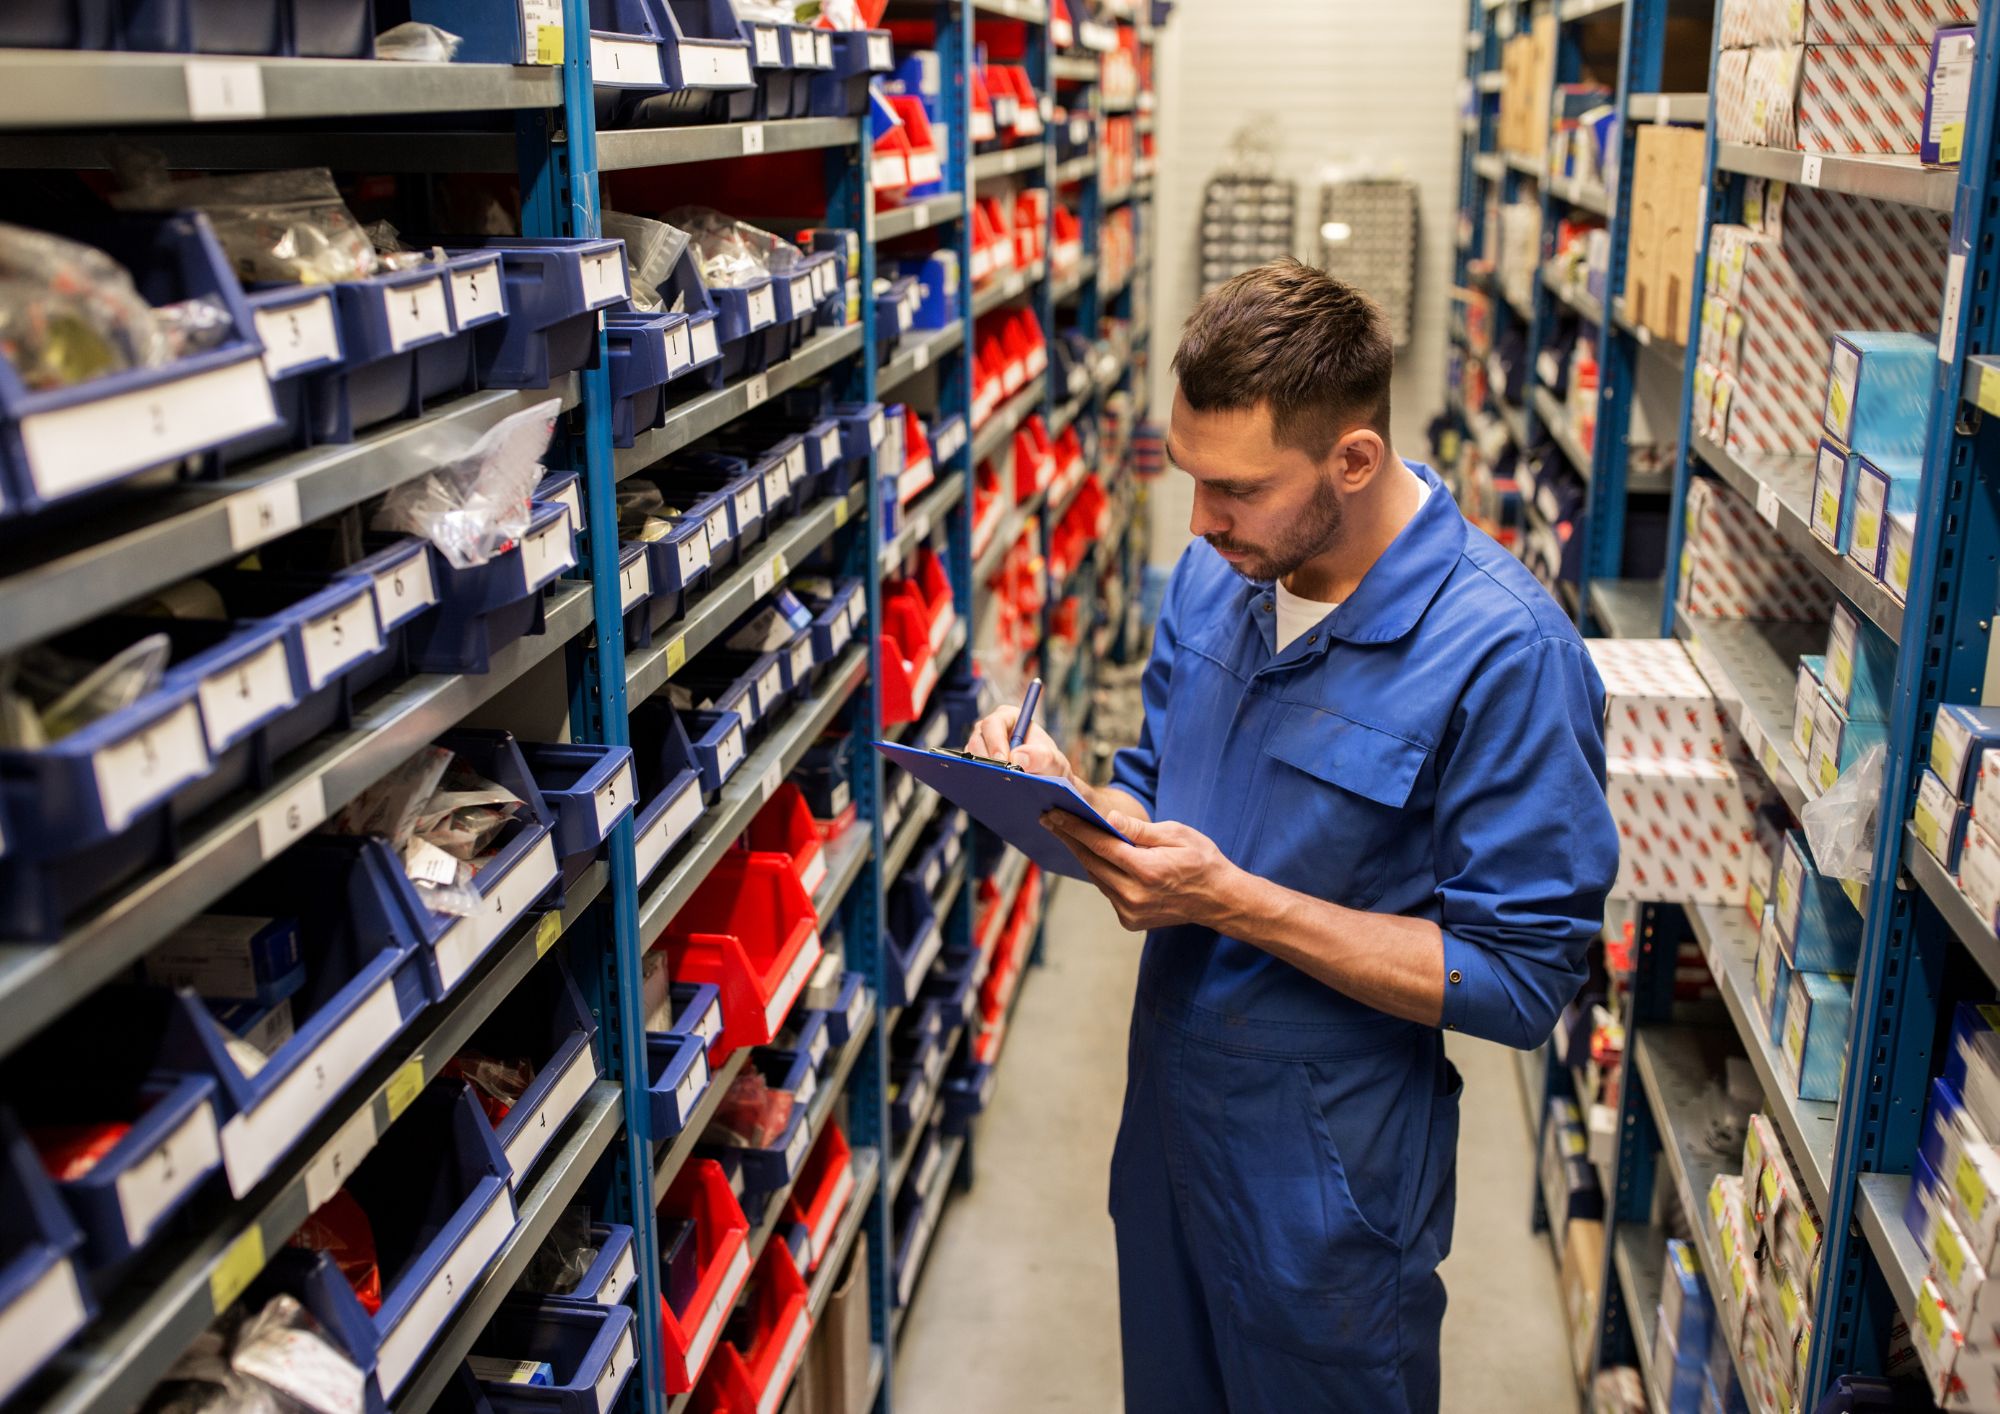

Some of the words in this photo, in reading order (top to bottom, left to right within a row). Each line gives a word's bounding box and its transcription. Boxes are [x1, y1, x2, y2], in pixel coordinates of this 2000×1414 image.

[614, 52, 620, 70] 1
[469, 273, 479, 302] 5
[288, 313, 302, 348] 3
[672, 333, 679, 355] 1
[687, 541, 694, 562] 2
[627, 567, 633, 589] 1
[607, 781, 616, 806] 5
[663, 822, 668, 838] 1
[687, 1073, 694, 1091] 1
[540, 1111, 548, 1129] 4
[445, 1273, 454, 1296] 3
